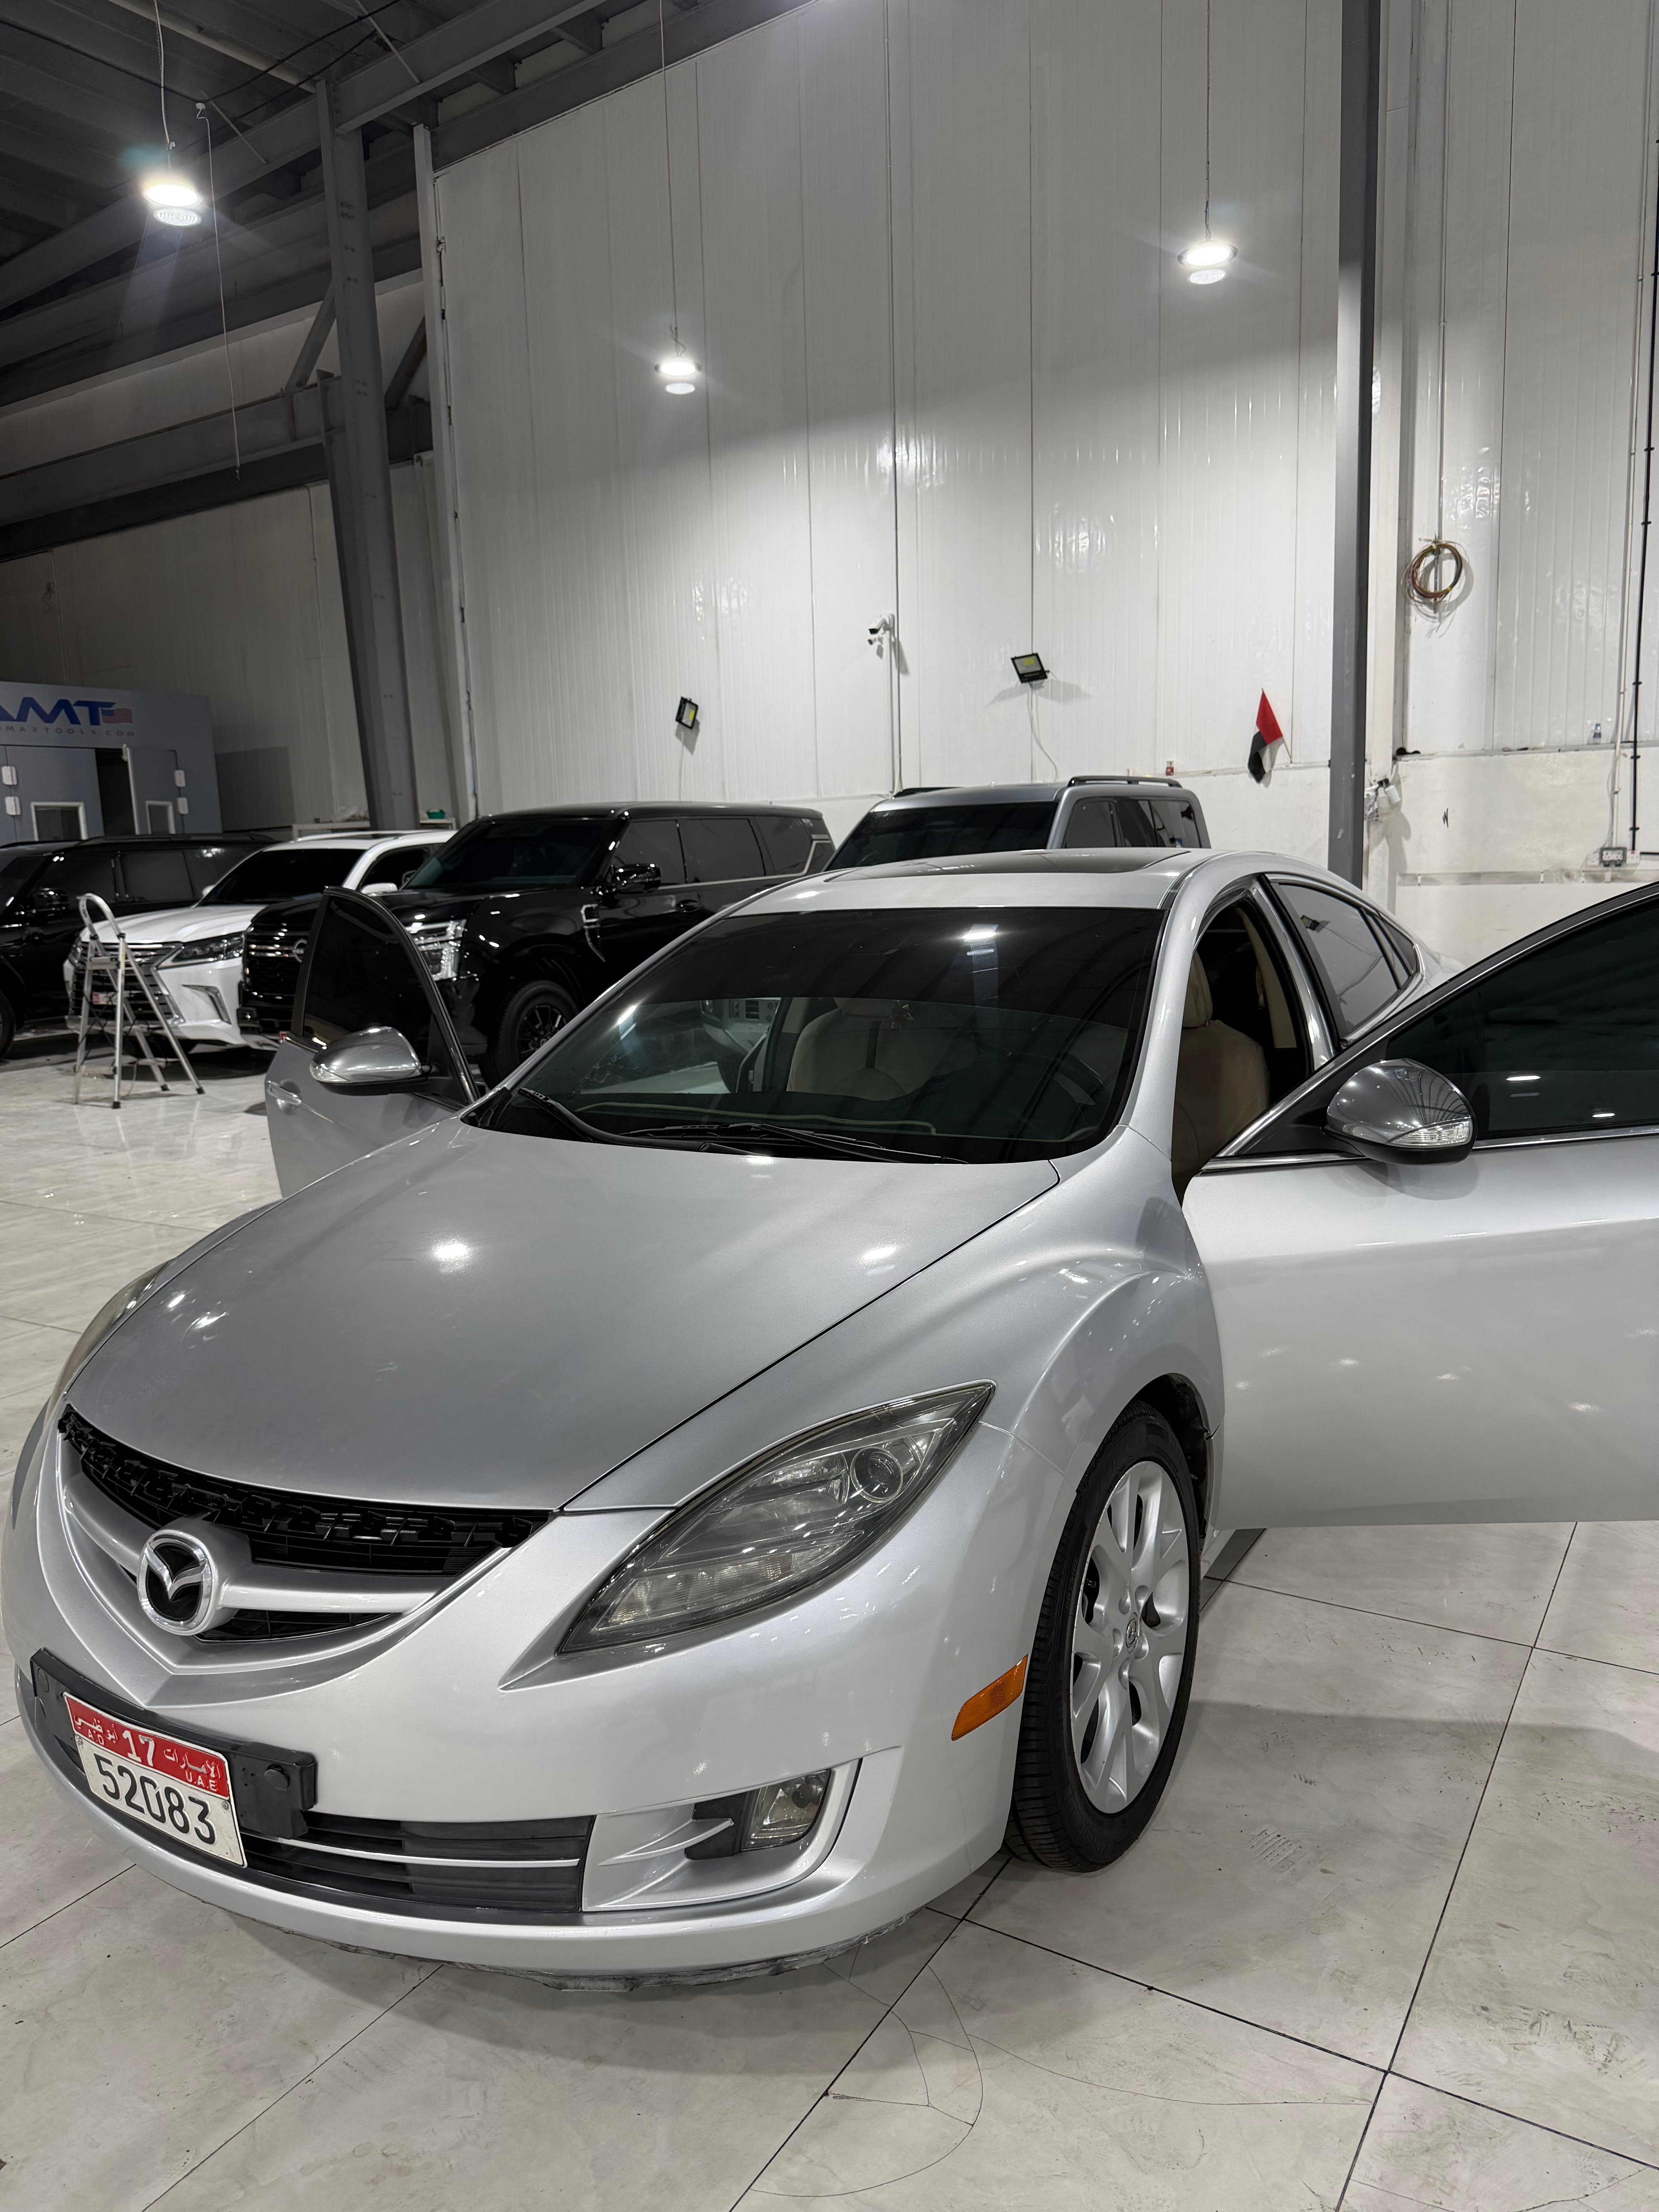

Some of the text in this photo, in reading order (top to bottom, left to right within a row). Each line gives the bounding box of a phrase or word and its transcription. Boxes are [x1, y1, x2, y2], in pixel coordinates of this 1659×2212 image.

[0, 726, 135, 736] MAXTOOLS.COM
[122, 1730, 155, 1767] 17
[185, 1770, 217, 1792] U.A.E
[94, 1753, 216, 1844] 52083
